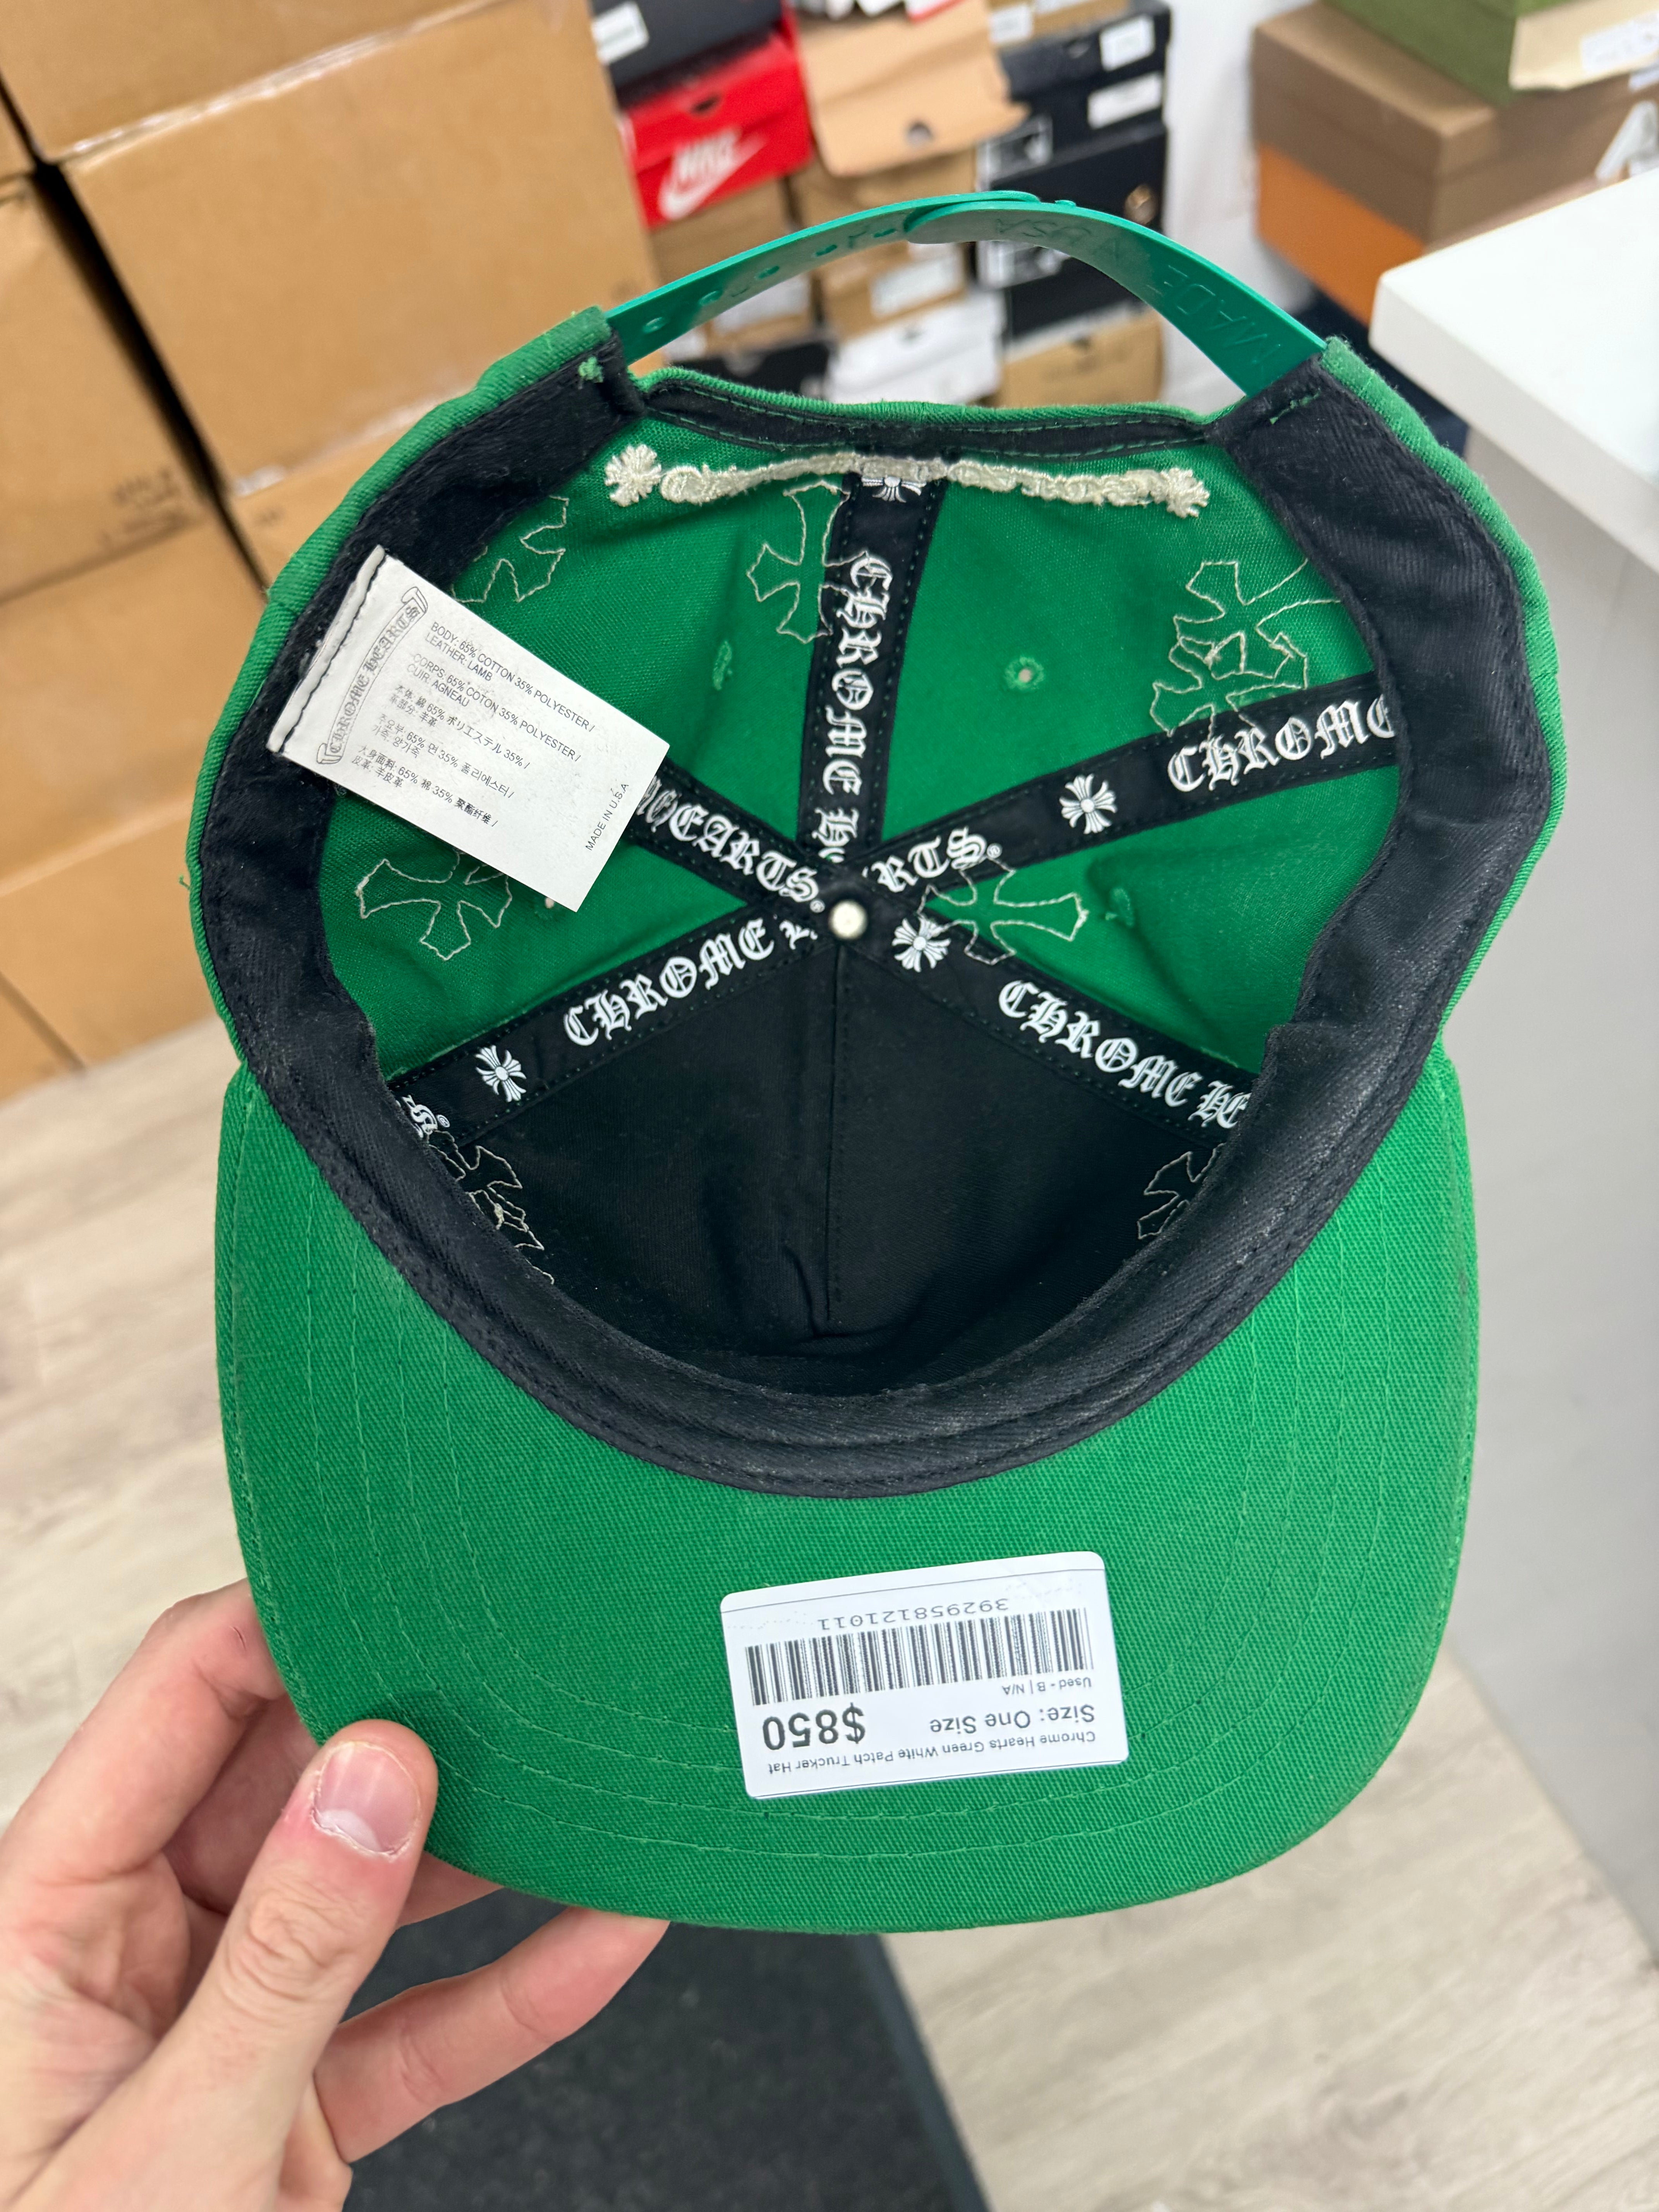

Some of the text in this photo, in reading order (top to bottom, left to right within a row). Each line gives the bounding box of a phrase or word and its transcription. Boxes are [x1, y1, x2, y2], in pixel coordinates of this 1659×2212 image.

[330, 604, 421, 753] CHROME HEARTS
[425, 632, 492, 681] LEATHER: LAMB
[431, 621, 459, 646] BODY:
[459, 641, 477, 658] 65%
[477, 654, 515, 682] COTTON
[515, 677, 533, 694] 35%
[534, 690, 589, 730] POLYESTER
[823, 555, 893, 795] CHROME
[407, 664, 469, 706] CUIR: AGNEAU
[414, 654, 446, 680] CORPS:
[447, 675, 465, 691] 65%
[466, 687, 499, 713] COTON
[499, 708, 518, 725] 35%
[519, 720, 575, 760] POLYESTER
[393, 737, 421, 758] 양가죽
[427, 704, 445, 720] 65%
[447, 716, 501, 753] ポリエステル
[504, 750, 523, 766] 35%
[398, 767, 418, 783] 65%
[421, 779, 431, 790] 棉
[433, 786, 453, 803] 35%
[407, 732, 426, 748] 65%
[428, 743, 439, 755] 면
[438, 750, 458, 767] 35%
[461, 763, 509, 796] 폴리에스터
[586, 822, 606, 850] MADE
[603, 810, 613, 821] IN
[563, 918, 774, 1046] CHROME
[999, 980, 1203, 1107] CHROME
[817, 1599, 1008, 1630] 392958121011
[1002, 1684, 1025, 1695] N/A
[1037, 1682, 1046, 1692] B
[1059, 1677, 1091, 1690] Used
[763, 1702, 865, 1750] $850
[930, 1704, 1094, 1734] Size: One Size
[768, 1731, 1095, 1774] Chrome Hearts Green White Patch Trucker Hat
